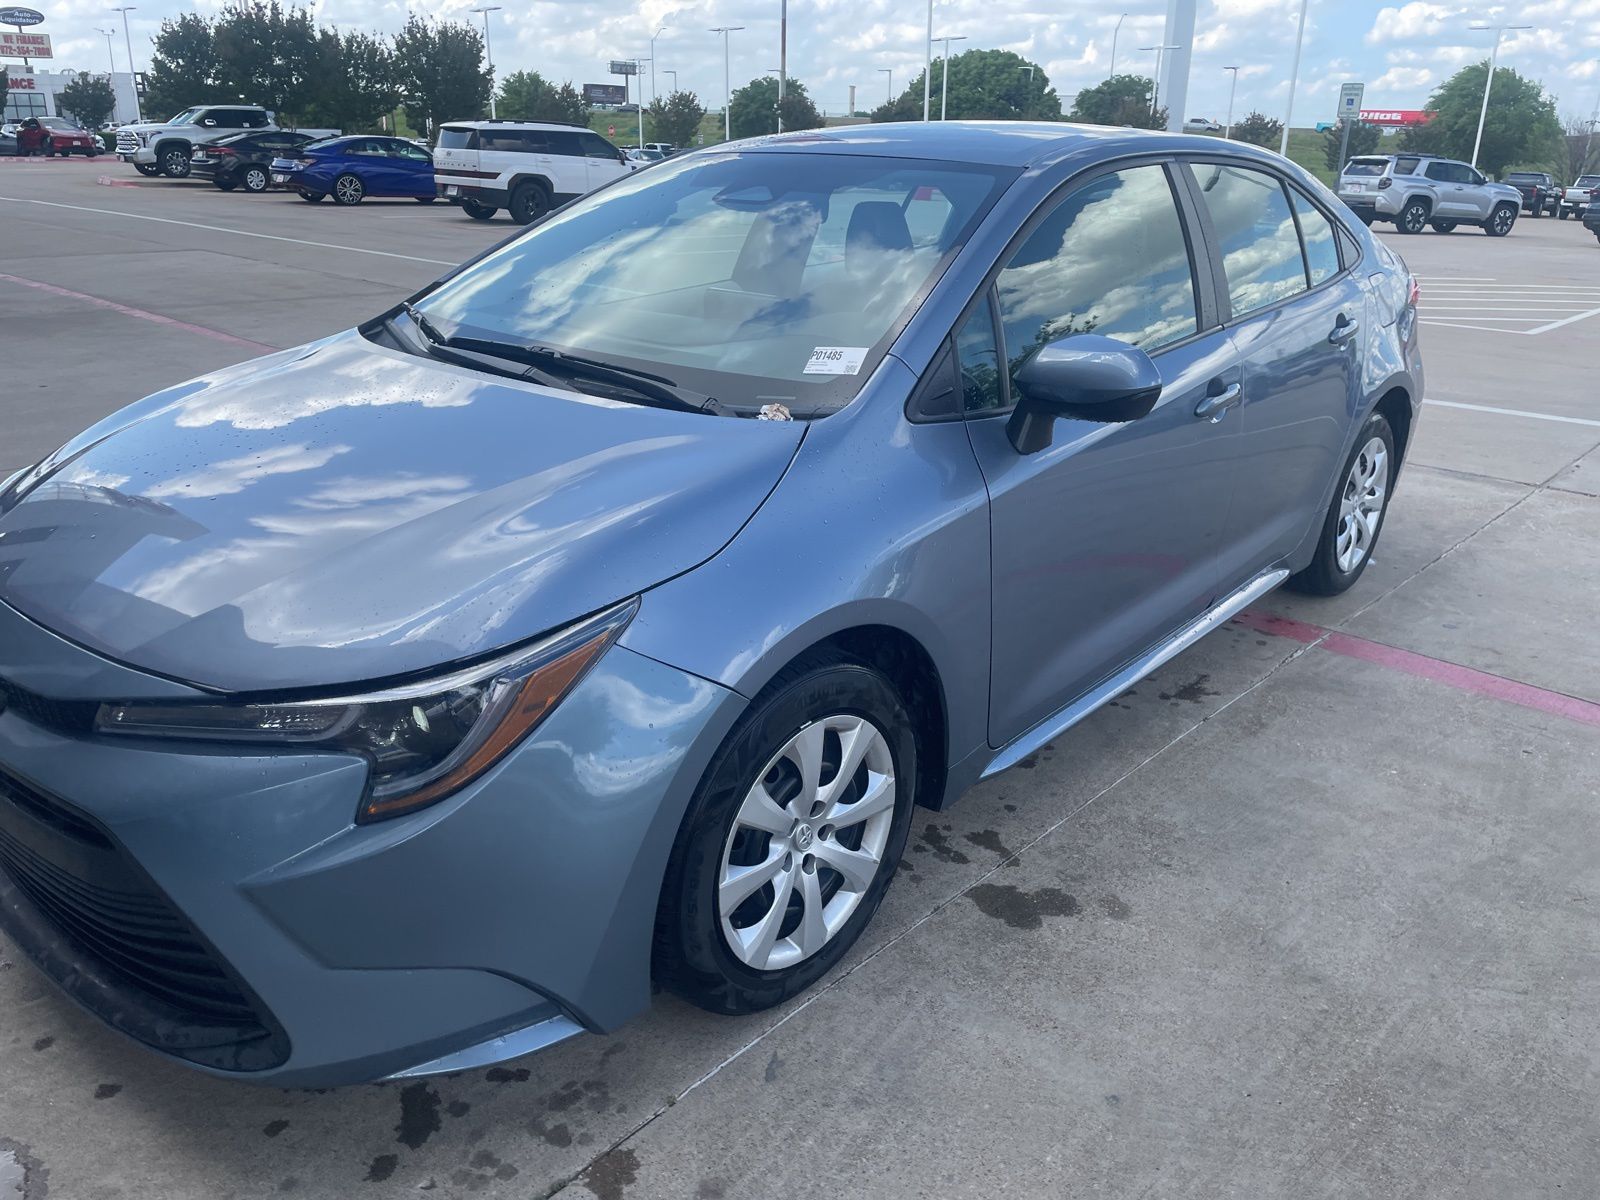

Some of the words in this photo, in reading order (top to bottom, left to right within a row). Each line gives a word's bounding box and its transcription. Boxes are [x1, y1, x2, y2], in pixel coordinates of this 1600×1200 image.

[0, 16, 40, 24] Liquidators
[3, 34, 14, 44] WE
[811, 351, 843, 360] P01485
